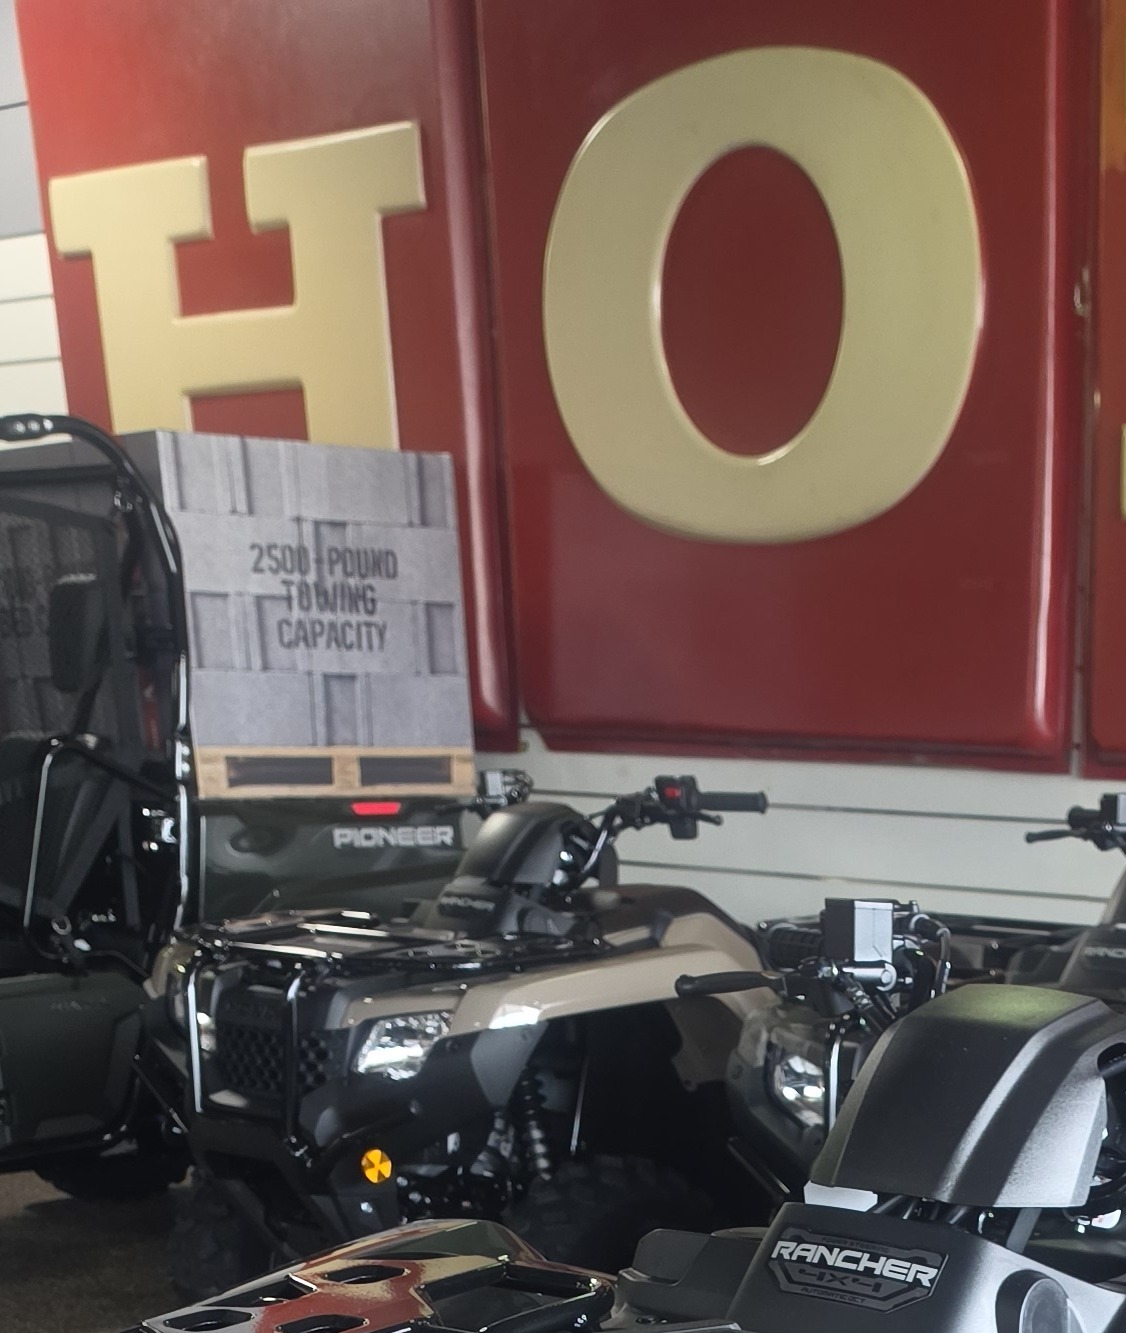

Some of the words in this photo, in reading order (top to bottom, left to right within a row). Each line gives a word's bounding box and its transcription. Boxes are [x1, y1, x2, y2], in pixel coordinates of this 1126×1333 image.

[280, 578, 377, 616] TOWING
[276, 617, 388, 652] CAPACITY
[333, 825, 455, 848] PIONEER
[771, 1240, 939, 1288] RANCHER
[800, 1286, 848, 1300] AUTOMATIC
